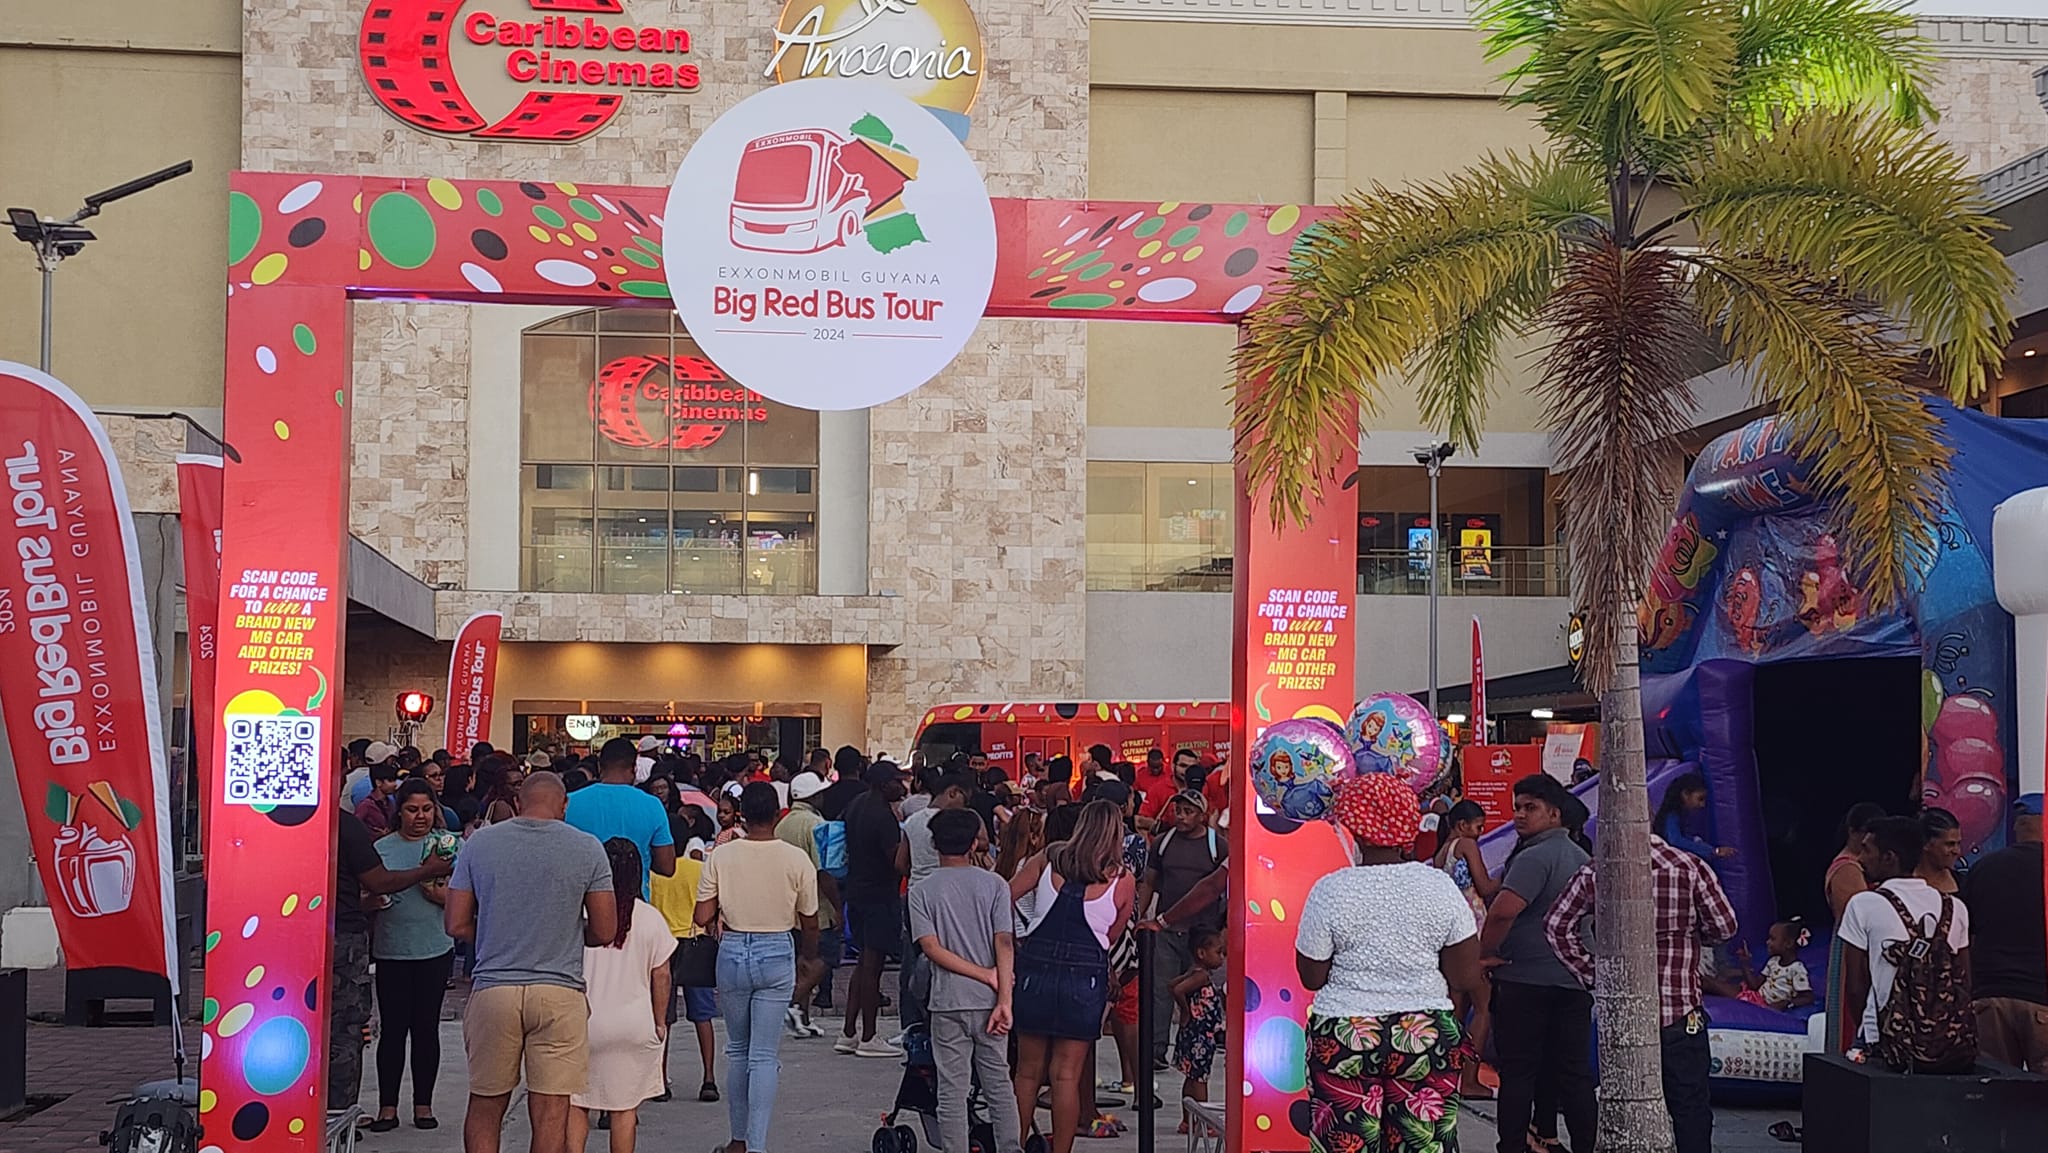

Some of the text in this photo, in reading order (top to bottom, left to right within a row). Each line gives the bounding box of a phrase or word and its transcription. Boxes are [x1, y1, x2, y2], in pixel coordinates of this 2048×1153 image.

[464, 11, 691, 53] Caribbean
[764, 4, 977, 79] Amazonia
[506, 48, 700, 88] Cinemas
[755, 134, 814, 148] EXXONMOBIL
[718, 266, 941, 286] EXXONMOBIL GUYANA
[714, 286, 944, 322] Big Red Bus Tour
[813, 328, 845, 341] 2024
[643, 382, 762, 403] Caribbean
[665, 402, 767, 421] Cinemas
[241, 570, 318, 585] SCAN CODE
[230, 584, 328, 601] FOR A CHANCE
[1268, 589, 1338, 604] SCAN CODE
[245, 599, 311, 615] TO win A
[1258, 603, 1347, 618] FOR A CHANCE
[235, 615, 316, 630] BRAND NEW
[1272, 617, 1333, 632] TO win A
[250, 630, 303, 645] MG CAR
[1264, 632, 1337, 647] BRAND NEW
[238, 645, 314, 660] AND OTHER
[471, 639, 486, 675] Tour
[1278, 647, 1326, 661] MG CAR
[249, 660, 302, 675] PRIZES!
[1267, 661, 1336, 675] AND OTHER
[468, 675, 484, 705] Bus
[1277, 676, 1325, 690] PRIZES!
[455, 642, 472, 759] EXXONMOBIL GUYANA
[465, 705, 481, 738] Red
